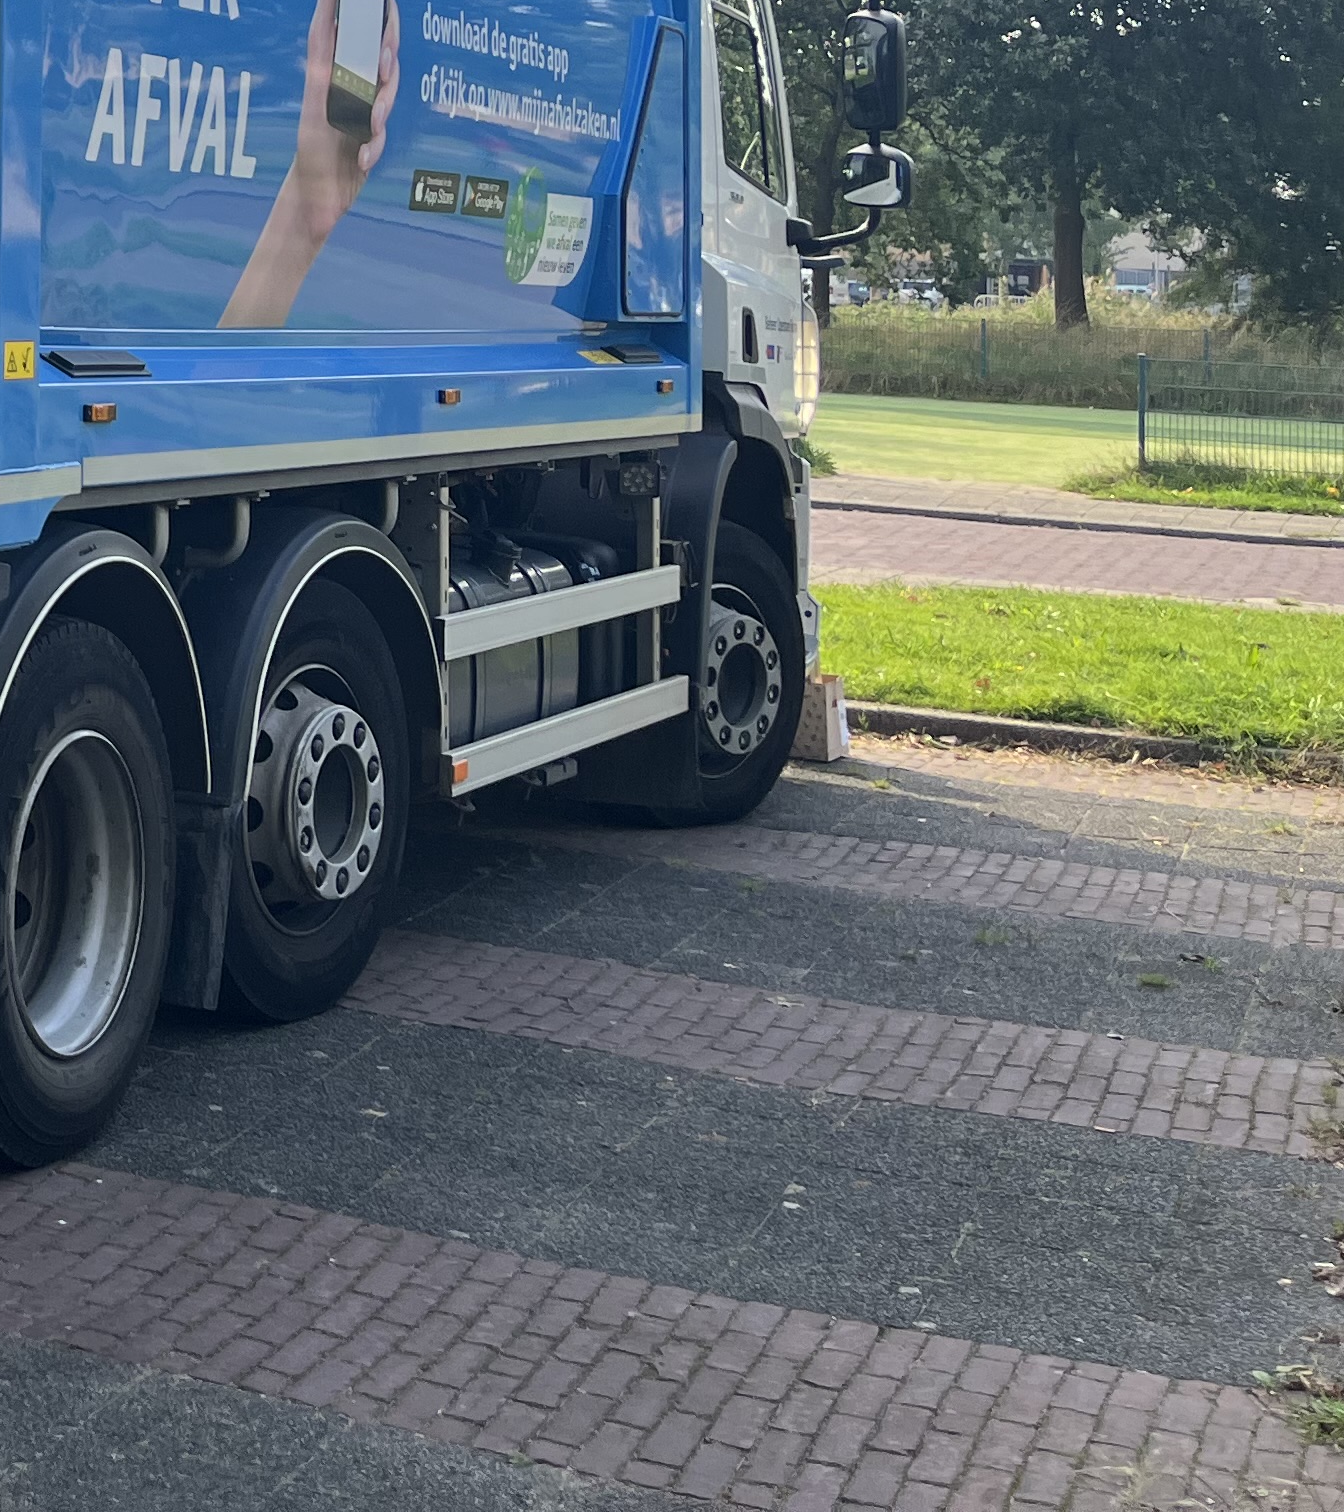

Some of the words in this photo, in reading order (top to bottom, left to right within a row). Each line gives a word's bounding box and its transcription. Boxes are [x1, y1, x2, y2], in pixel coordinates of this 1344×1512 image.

[422, 1, 489, 55] download
[491, 19, 507, 60] de
[509, 31, 546, 72] gratis
[547, 43, 570, 84] app
[85, 46, 259, 179] AFVAL
[420, 64, 439, 103] of
[438, 66, 466, 119] kijk
[468, 83, 486, 122] op
[487, 87, 622, 143] www.mijnafvalzaken.nl
[424, 187, 438, 207] App
[437, 188, 455, 205] Store
[474, 192, 494, 213] Google
